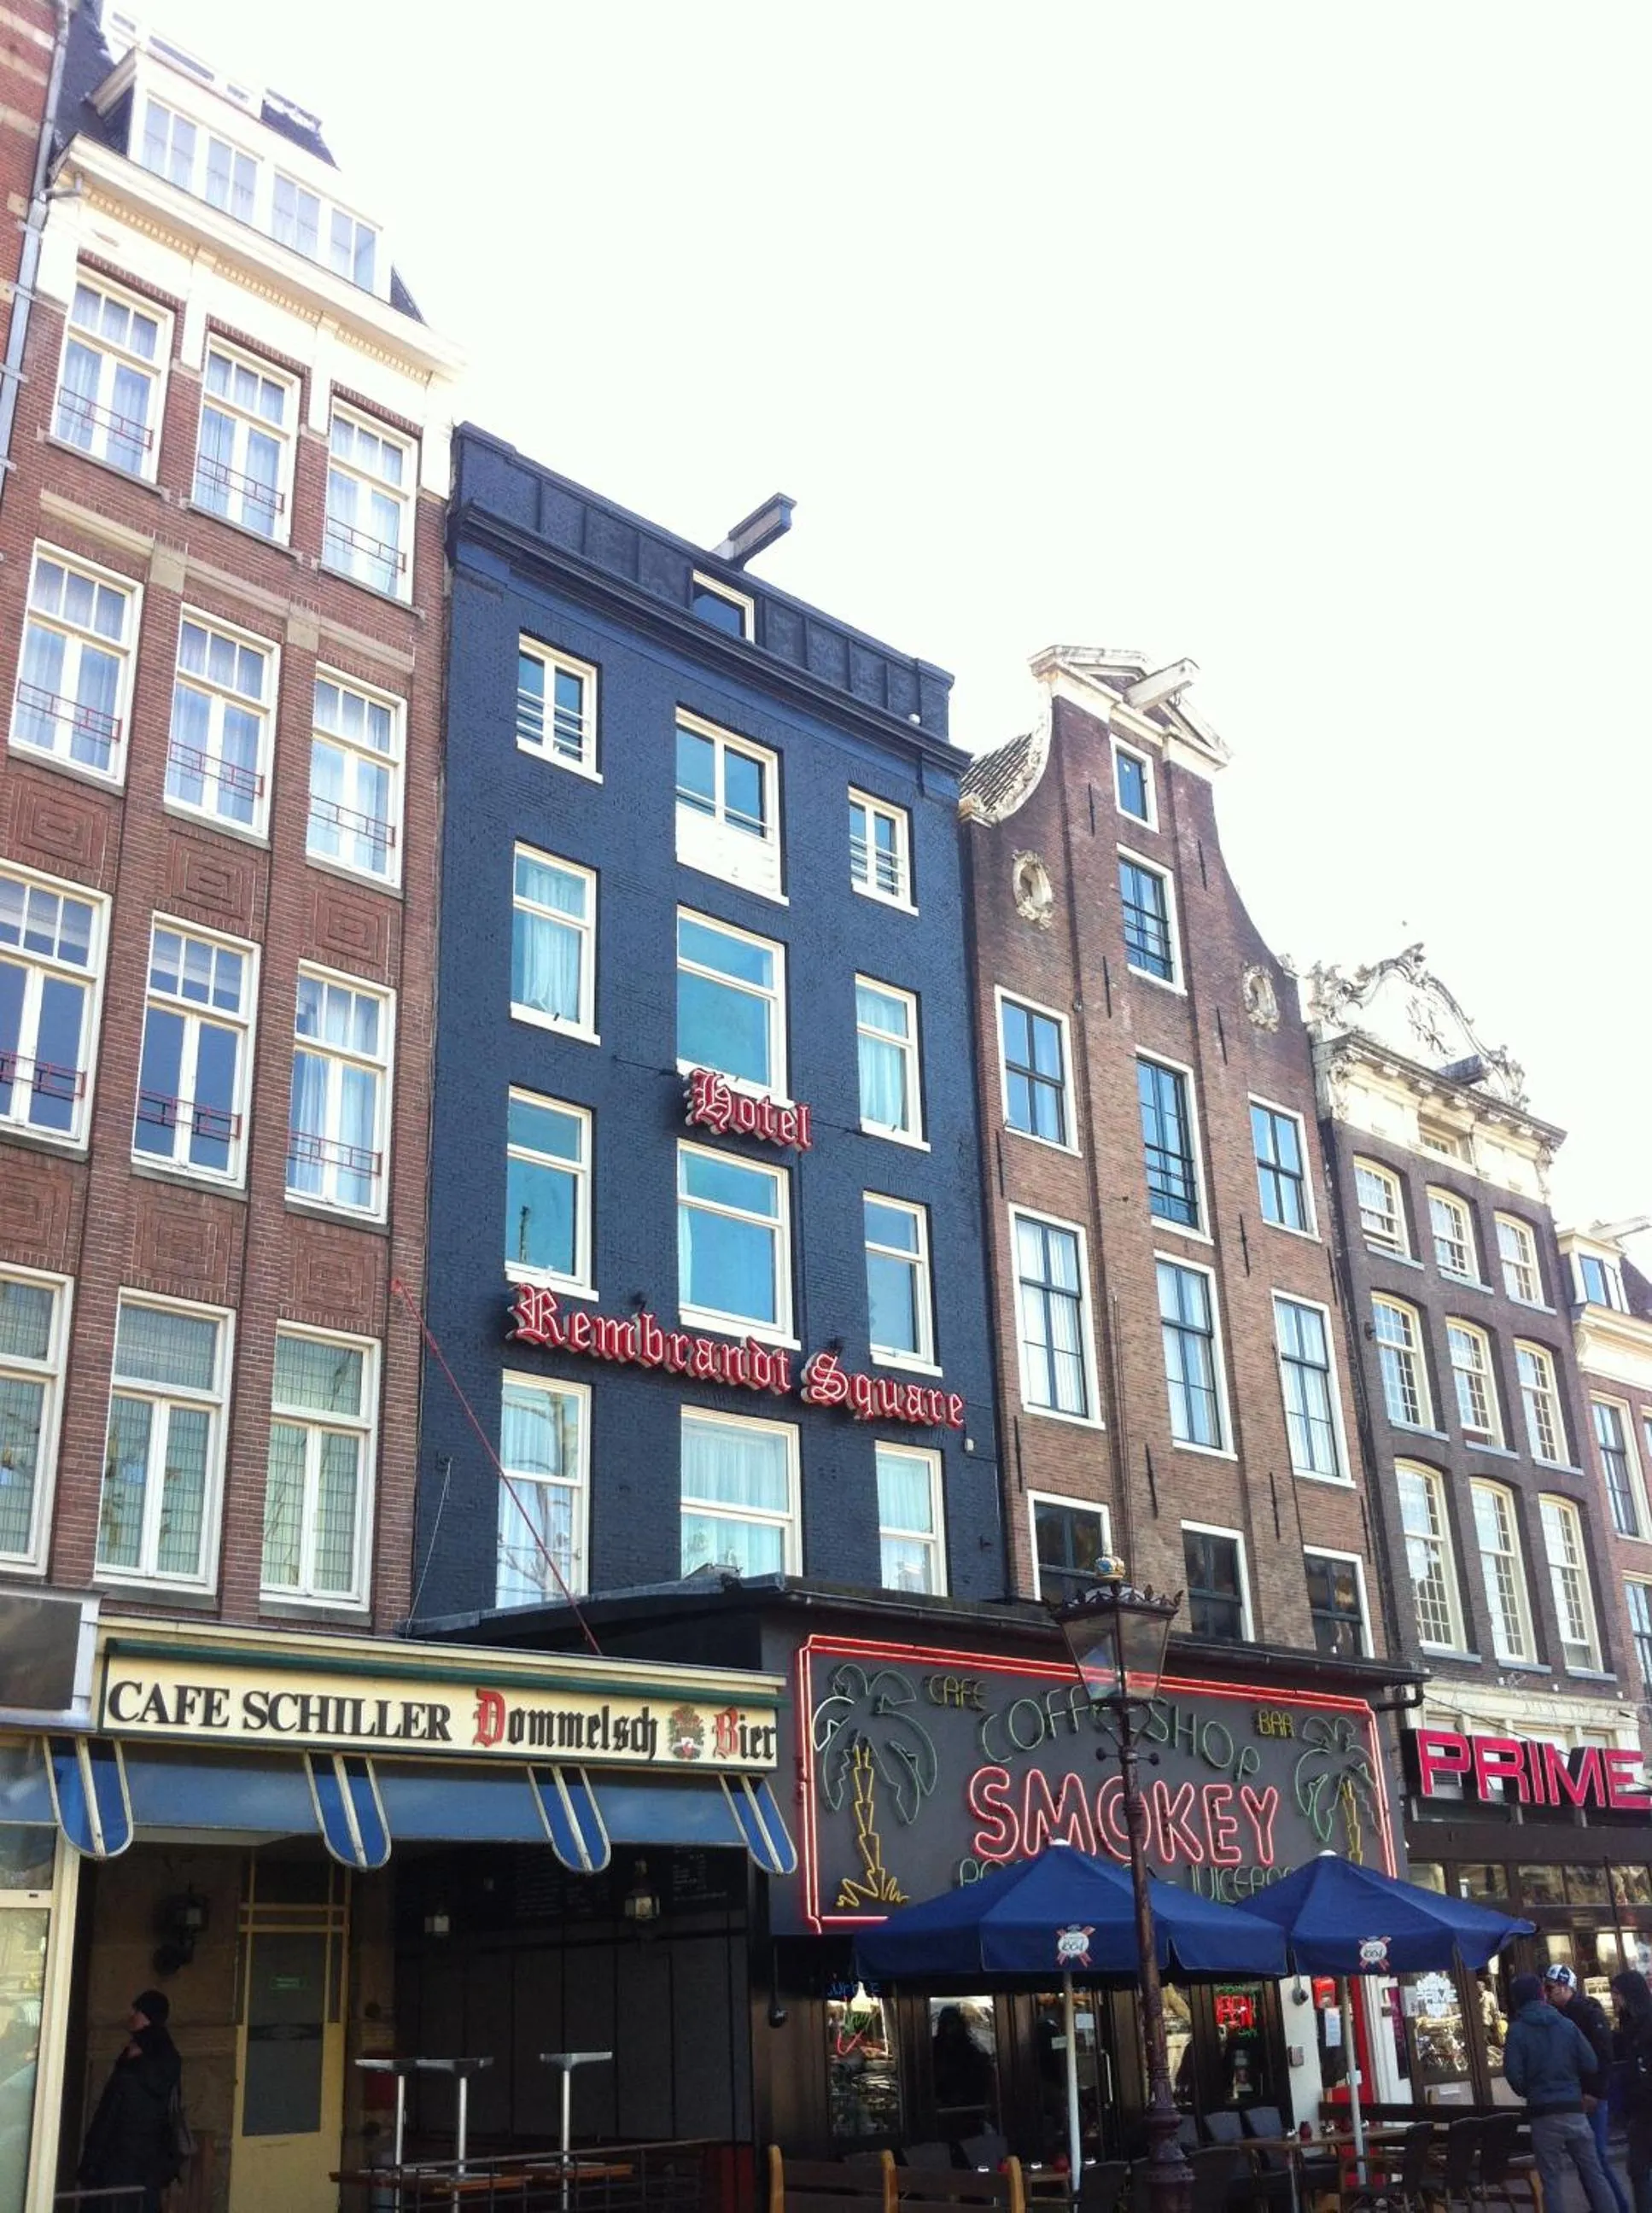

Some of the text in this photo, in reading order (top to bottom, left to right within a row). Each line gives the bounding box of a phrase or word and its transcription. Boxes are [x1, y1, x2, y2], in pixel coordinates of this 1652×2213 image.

[686, 1067, 812, 1151] Hotel
[508, 1282, 964, 1429] Rembrandt Square
[108, 1680, 777, 1760] CAFE SCHILLER Dommelsch Bier
[928, 1673, 989, 1710] CAFE
[1258, 1709, 1295, 1738] BAR
[1415, 1728, 1652, 1810] PRIME
[968, 1765, 1280, 1866] SMOKEY
